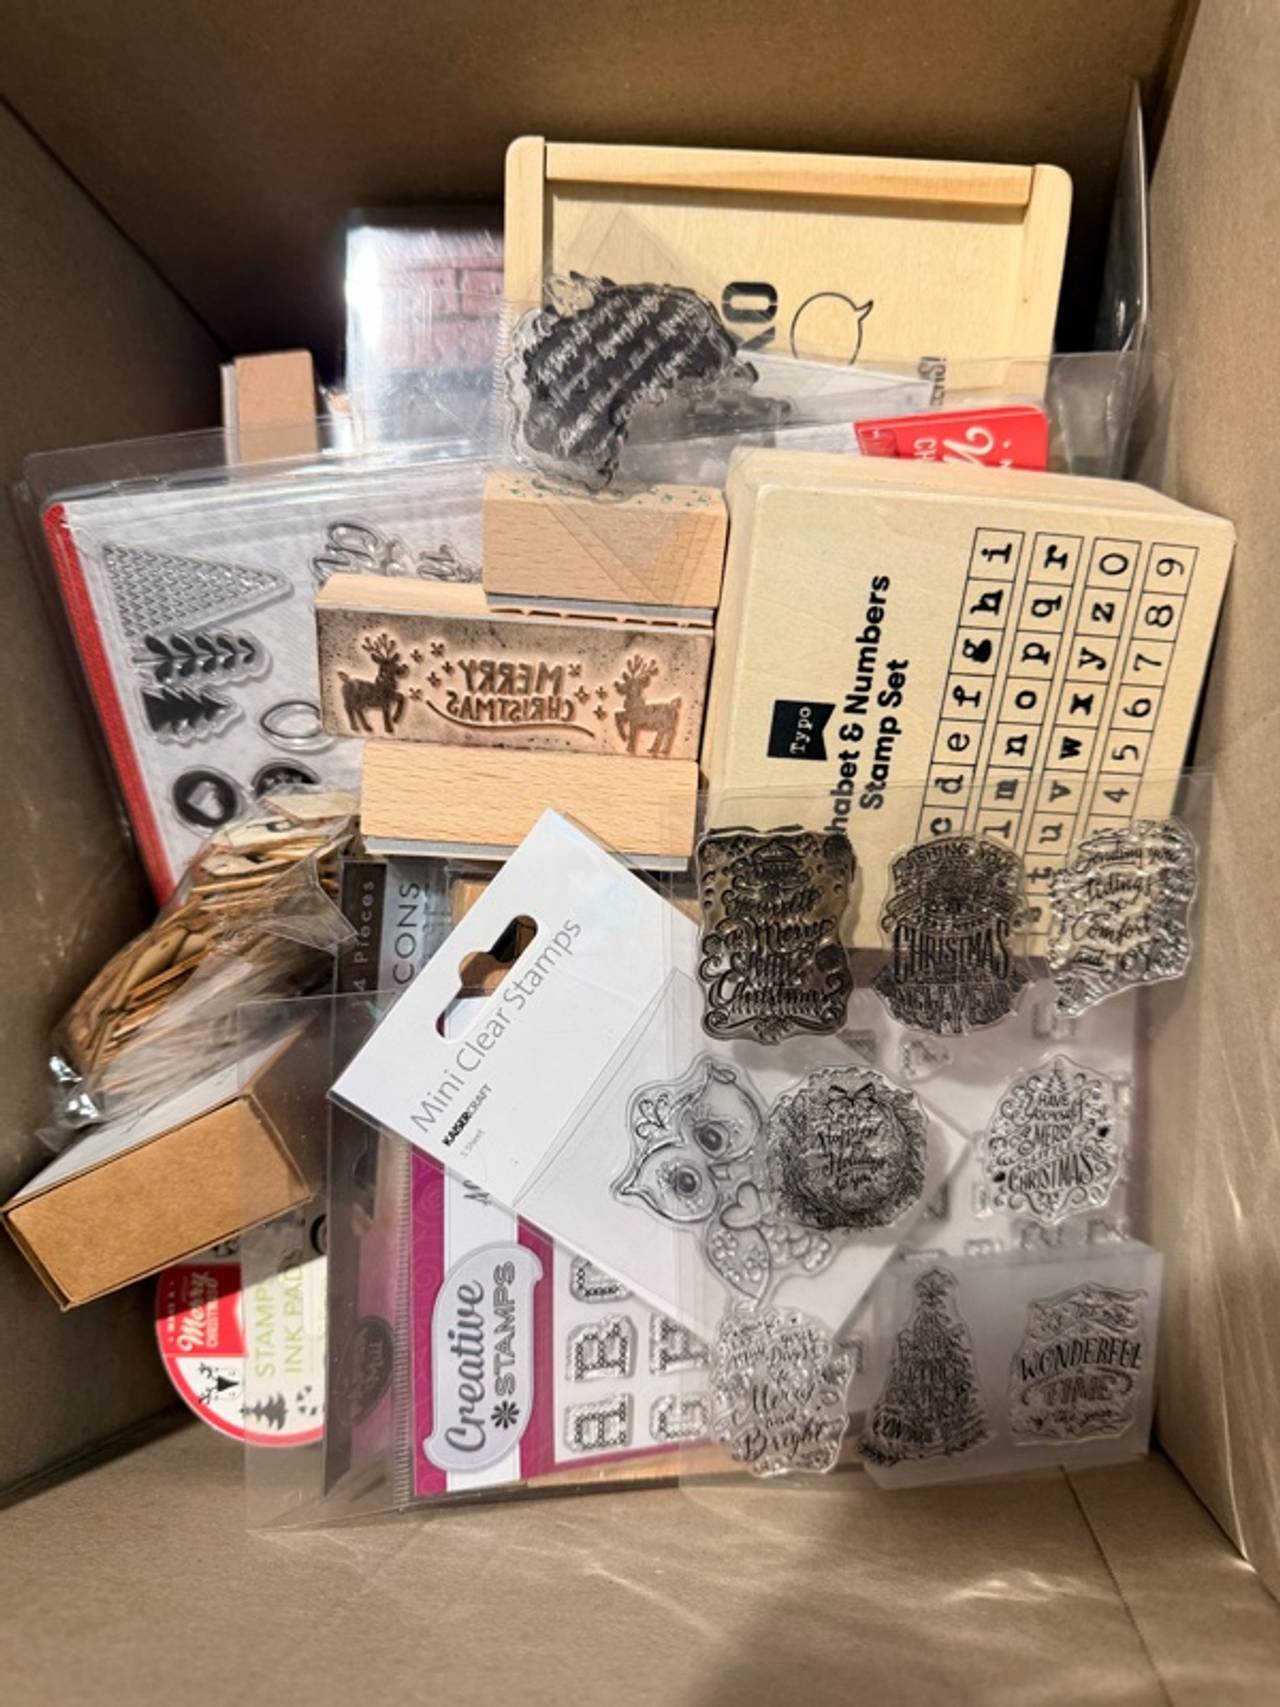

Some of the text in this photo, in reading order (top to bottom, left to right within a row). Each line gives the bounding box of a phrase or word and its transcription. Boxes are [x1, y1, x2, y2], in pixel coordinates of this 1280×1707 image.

[1044, 544, 1068, 570] r
[1030, 595, 1062, 618] q
[1091, 602, 1115, 623] z
[1021, 642, 1051, 666] p
[1078, 647, 1106, 671] y
[930, 543, 1012, 836] c d e f g h i
[1014, 690, 1037, 710] o
[1103, 558, 1184, 803] 4 5 6 7 8 9
[824, 575, 890, 833] habet & Numbers
[1069, 694, 1094, 716] x
[789, 706, 812, 754] Typo
[859, 659, 909, 810] Stamp Set
[1004, 734, 1028, 756] n
[1059, 736, 1082, 760] w
[995, 779, 1018, 800] m
[1049, 780, 1071, 802] v
[1039, 823, 1063, 844] u
[1072, 910, 1151, 946] Comfort
[893, 918, 1010, 983] CHRISTMAS
[410, 919, 582, 1133] Mini Clear Stamps
[441, 1083, 492, 1147] KAISERCRAFT
[1039, 1093, 1069, 1107] HAVE
[1009, 1151, 1094, 1192] CHRISTMAS
[176, 1271, 216, 1352] Merry
[493, 1261, 516, 1397] STAMPS
[284, 1329, 304, 1374] INK
[444, 1279, 486, 1452] Creative
[574, 1321, 629, 1381] B
[1021, 1338, 1141, 1380] WONDERFUL
[735, 1418, 828, 1461] Bright
